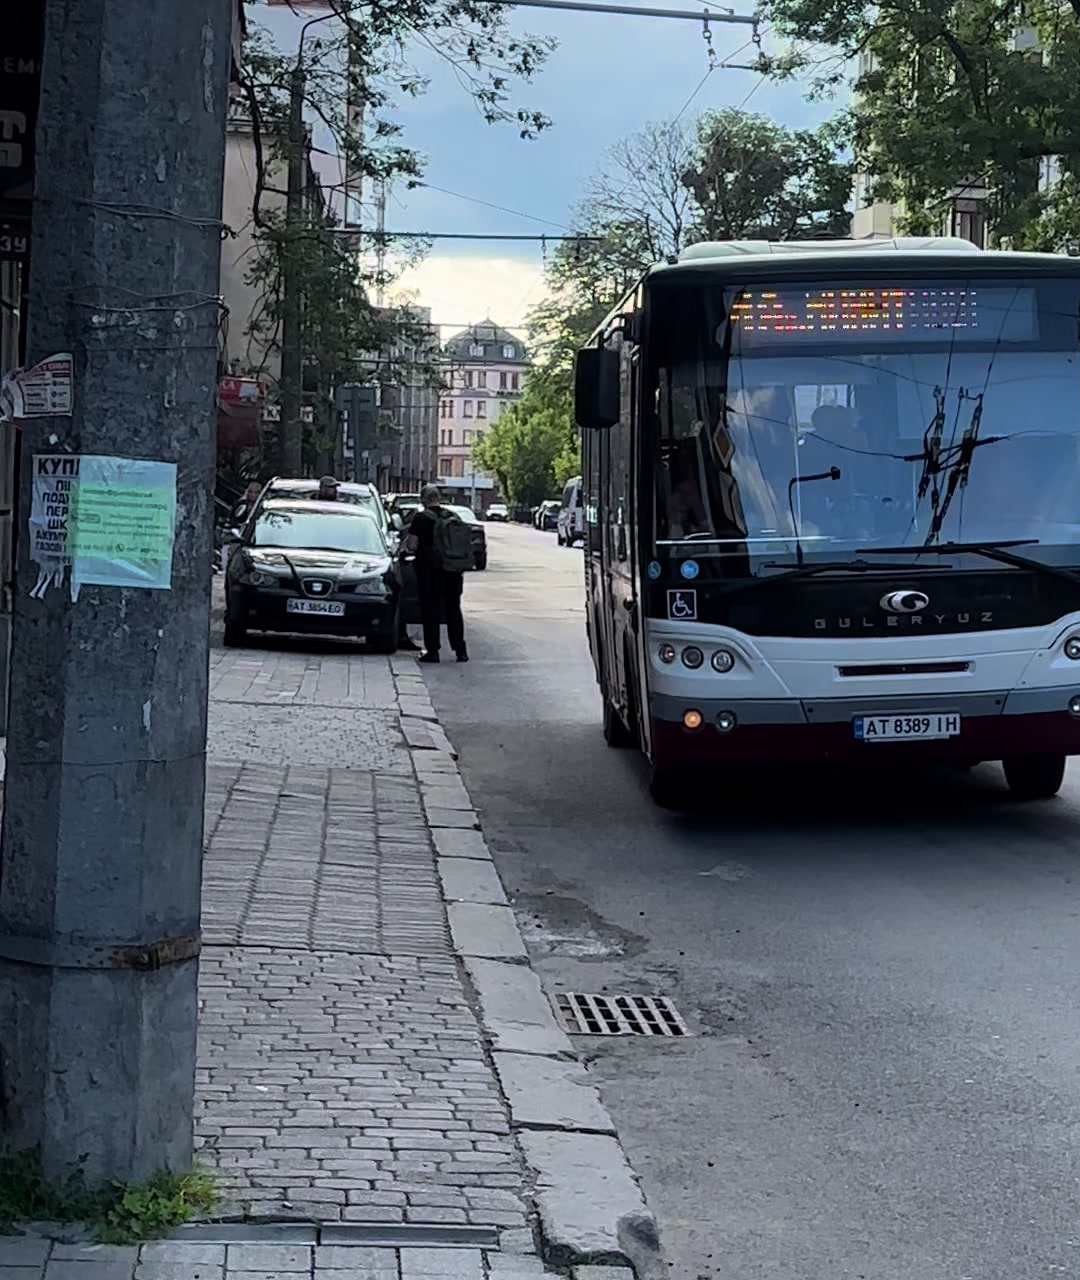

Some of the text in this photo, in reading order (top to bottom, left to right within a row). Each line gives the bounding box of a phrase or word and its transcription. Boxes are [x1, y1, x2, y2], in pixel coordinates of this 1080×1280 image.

[866, 717, 957, 735] AT 8389 IH
